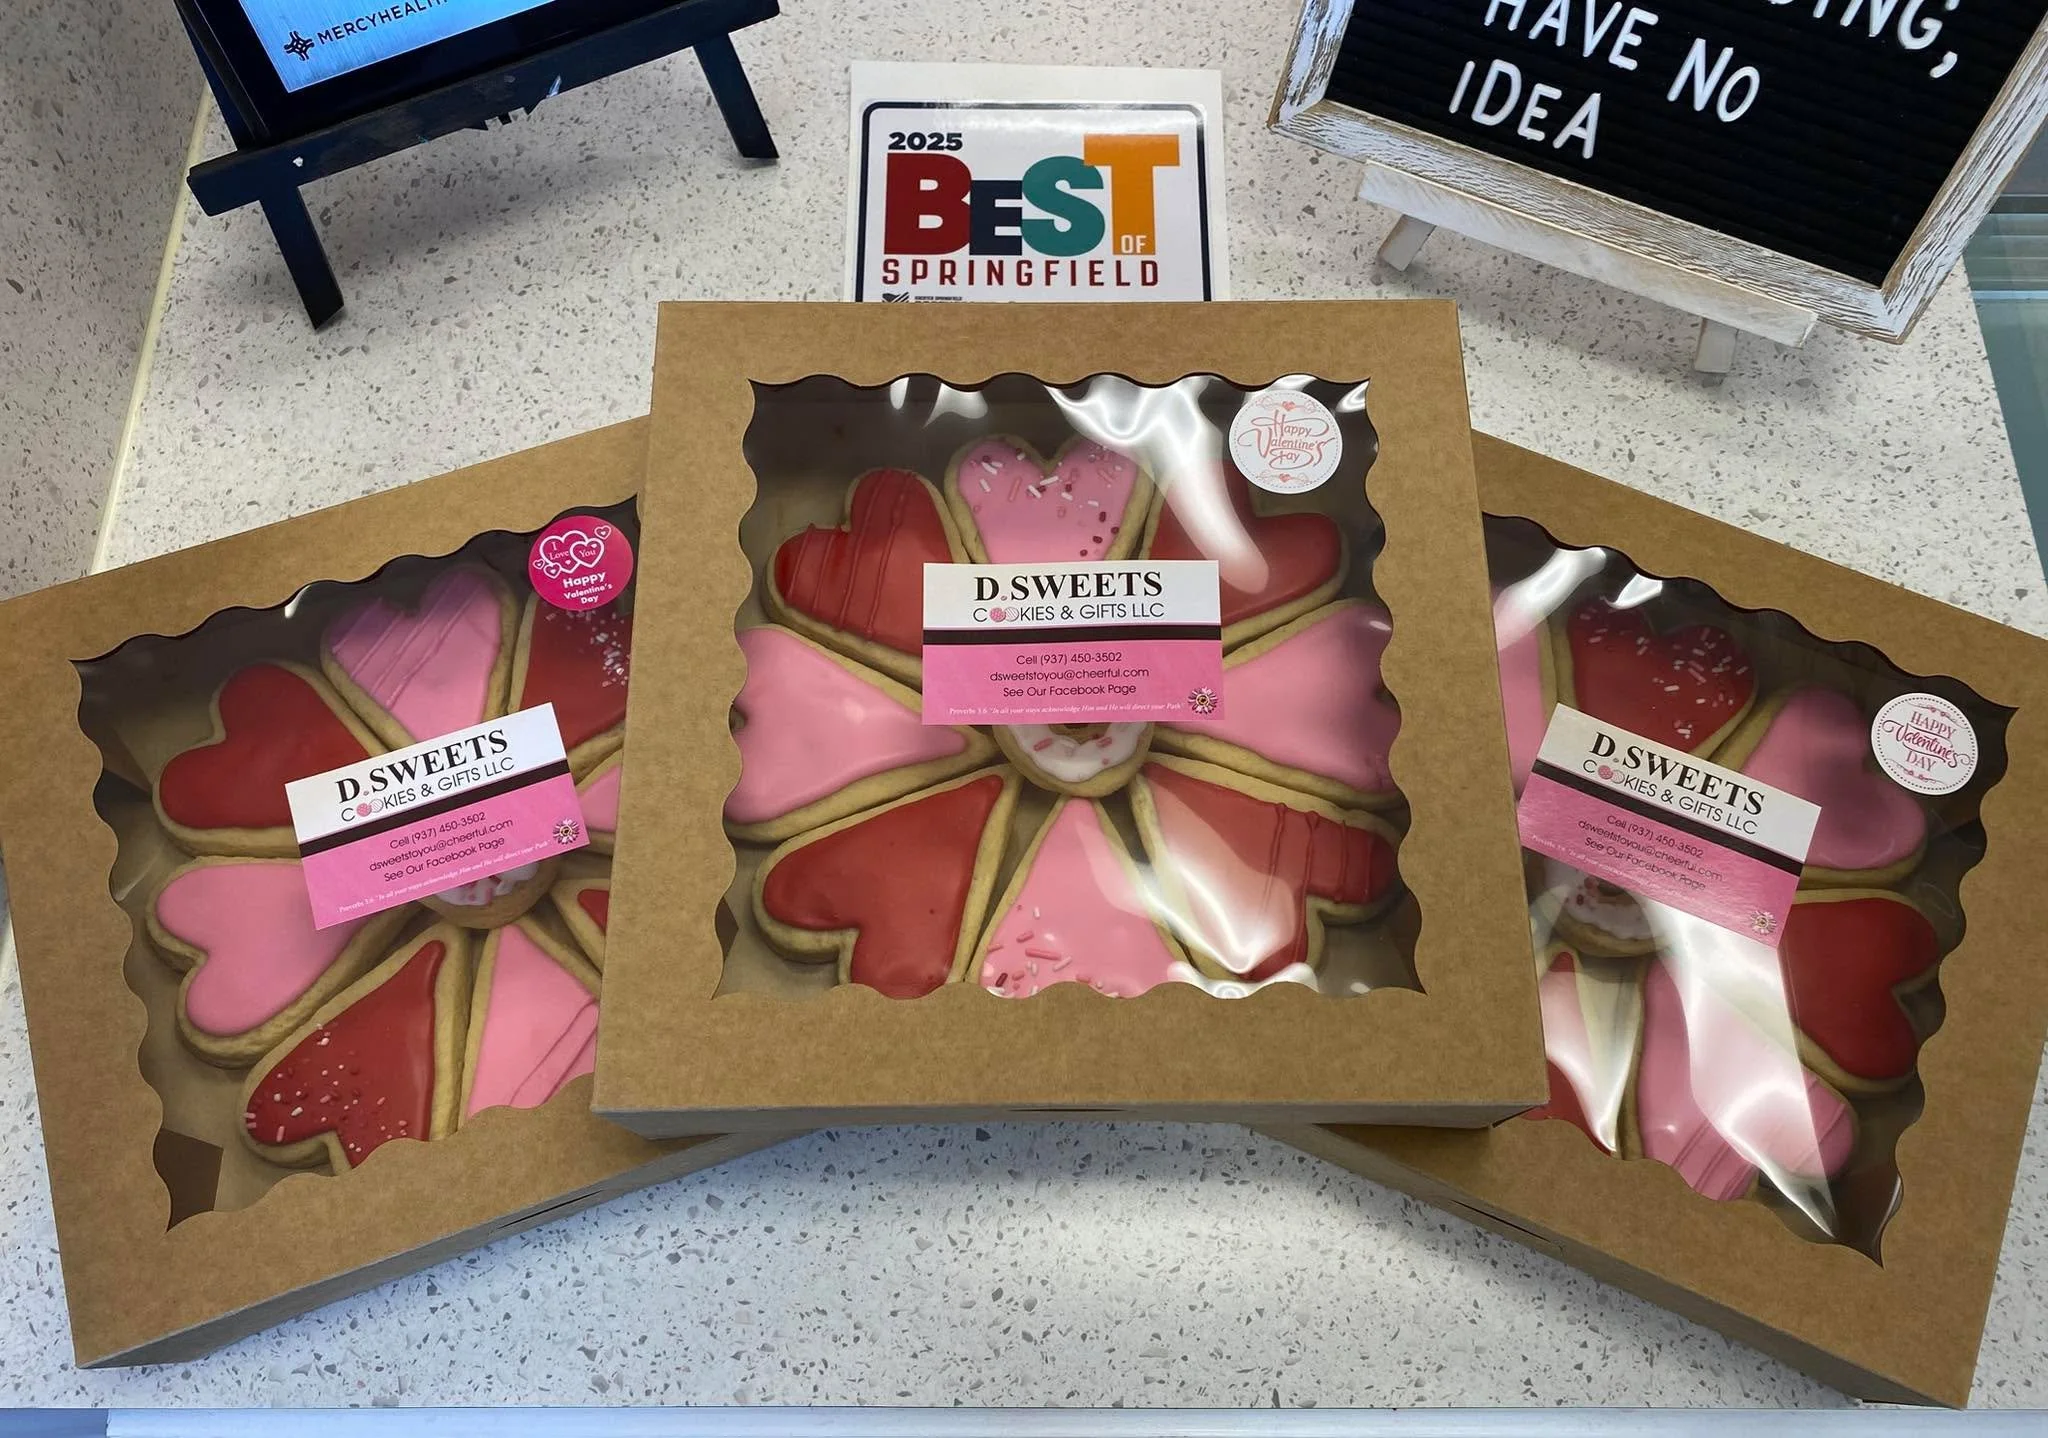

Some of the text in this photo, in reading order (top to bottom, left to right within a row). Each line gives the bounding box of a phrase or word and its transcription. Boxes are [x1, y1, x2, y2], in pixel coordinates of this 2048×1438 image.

[1667, 37, 1760, 122] NO
[1449, 59, 1600, 159] IDEA
[888, 132, 963, 151] 2025
[884, 134, 1180, 257] BEST
[1120, 235, 1147, 253] OF
[882, 258, 1159, 287] SPRINGFIELD
[1238, 427, 1335, 467] Valentine's
[1269, 448, 1314, 470] Day
[548, 549, 597, 560] Love You
[551, 541, 557, 551] I
[563, 572, 606, 588] Happy
[564, 583, 613, 599] Valentine's
[581, 595, 599, 604] Day
[1060, 605, 1074, 620] &
[1080, 603, 1127, 619] GIFTS
[1132, 603, 1165, 618] LLC
[1016, 652, 1122, 666] Cell (937) 450-3502
[990, 668, 1149, 681] dsweetstoyou@cheerful.com
[1003, 684, 1136, 697] See Our Facebook Page
[1910, 711, 1957, 739] HAPPY
[1906, 751, 1936, 771] DAY
[421, 784, 434, 798] &
[438, 768, 481, 791] GIFTS
[484, 757, 515, 777] LLC
[1660, 789, 1674, 805] &
[1679, 796, 1723, 822] GIFTS
[1726, 813, 1758, 835] LLC
[390, 812, 486, 849] Cell (937) 450-3502
[1607, 815, 1704, 859] Cell (937) 450-3502
[369, 819, 513, 871] dsweetstoyou@cheerful.com
[384, 837, 505, 882] See Our Facebook Page
[1584, 837, 1706, 890] See Our Facebook Page
